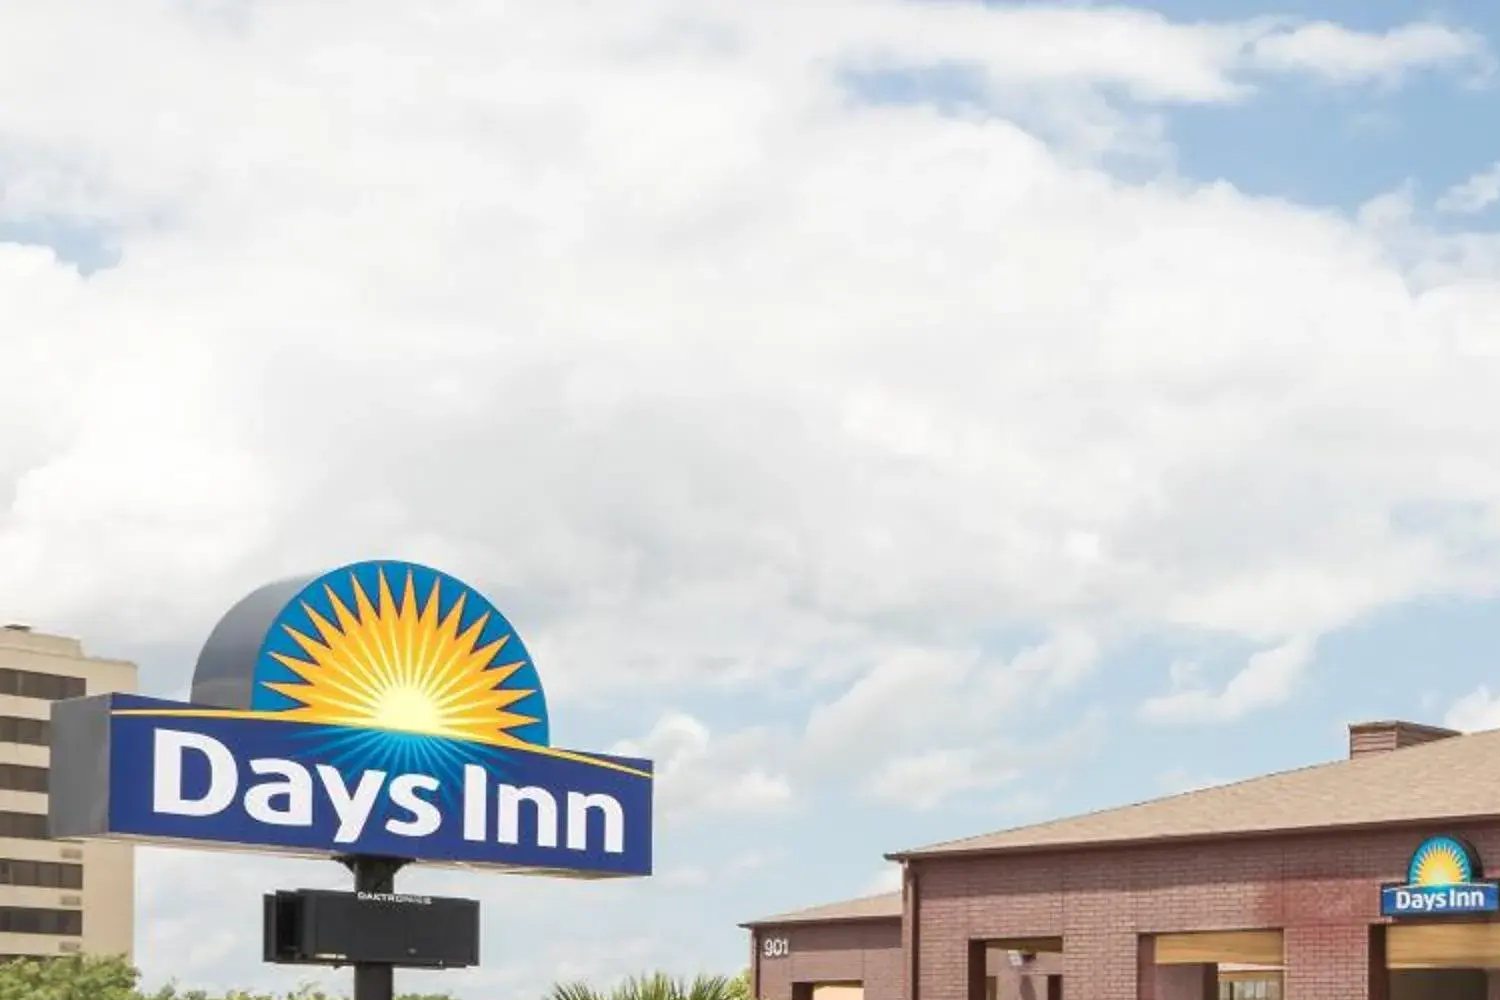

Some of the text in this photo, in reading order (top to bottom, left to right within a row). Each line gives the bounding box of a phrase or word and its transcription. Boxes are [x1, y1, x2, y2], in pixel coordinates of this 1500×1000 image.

[153, 728, 625, 853] Days Inn
[1395, 888, 1485, 911] Days Inn
[764, 938, 789, 957] 901
